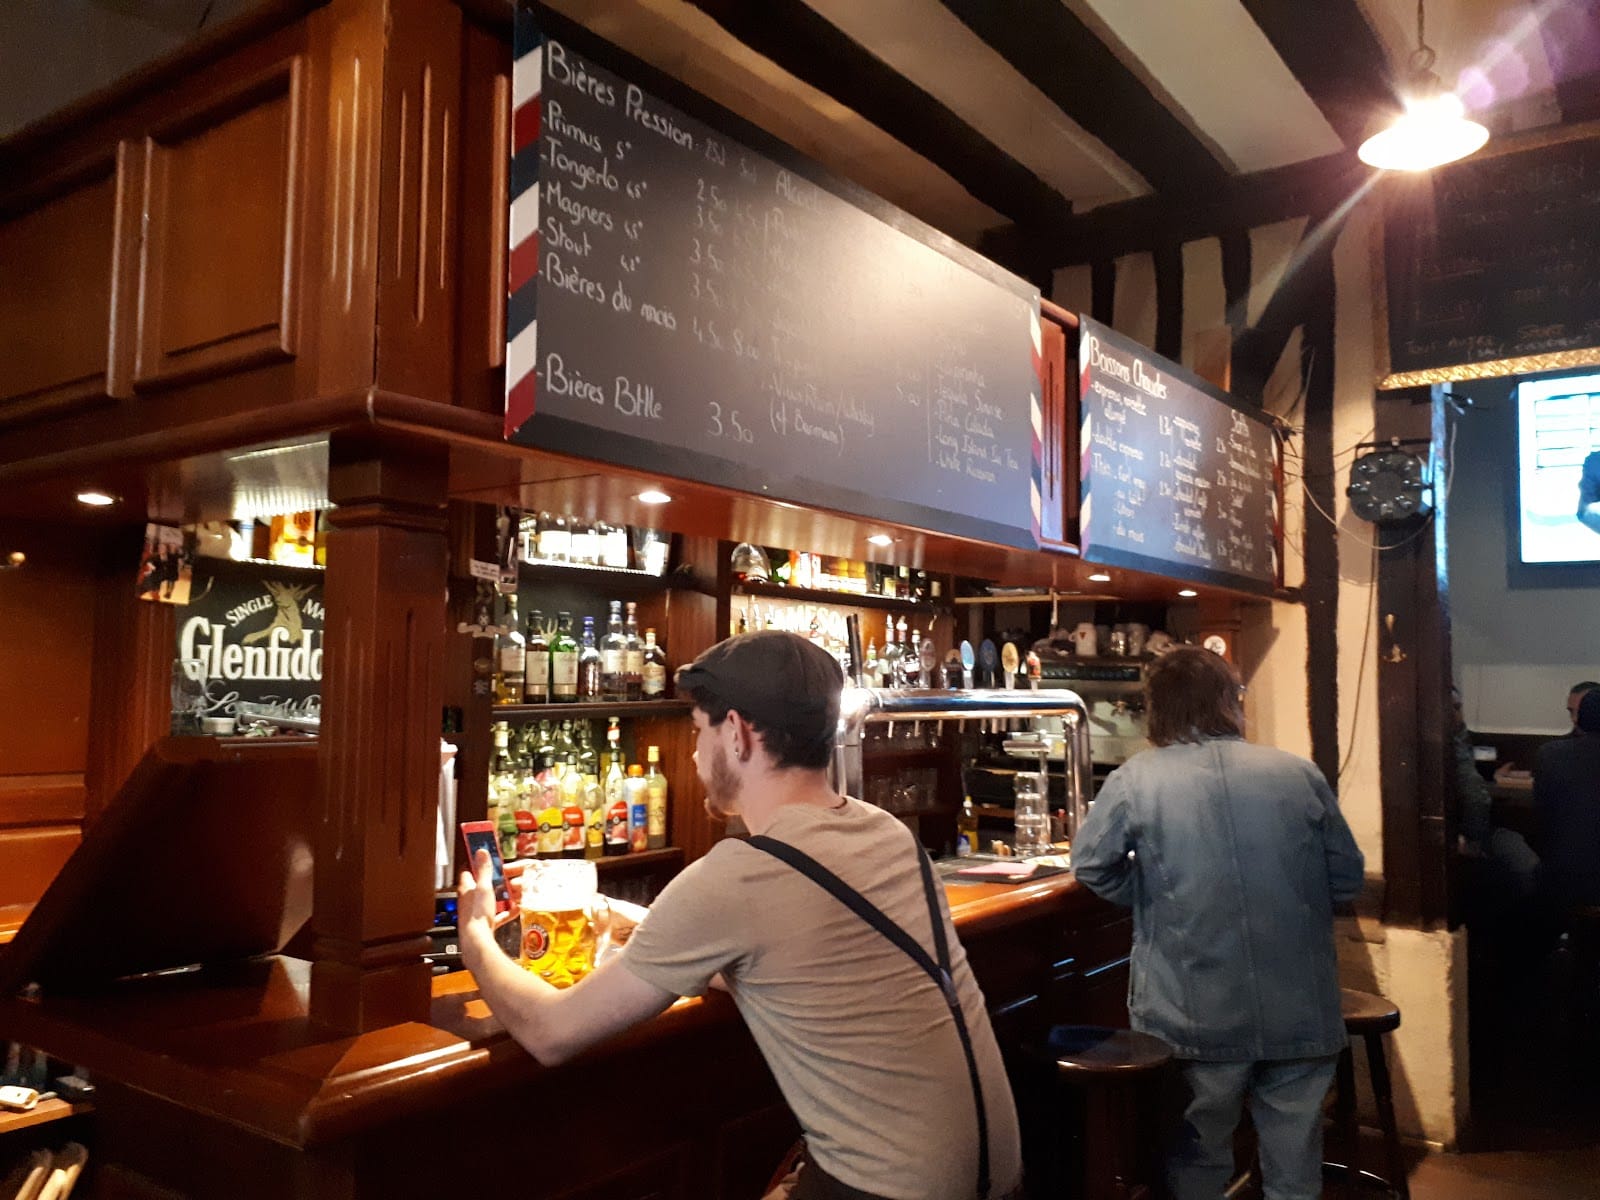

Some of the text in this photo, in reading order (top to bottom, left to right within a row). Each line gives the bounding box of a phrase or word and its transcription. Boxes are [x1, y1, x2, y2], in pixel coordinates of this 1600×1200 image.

[546, 40, 616, 107] Bières
[625, 84, 694, 150] Pression
[548, 99, 602, 153] Primus
[544, 135, 619, 191] Tongerlo
[546, 181, 613, 232] Magners
[546, 216, 592, 257] Stout
[546, 252, 605, 303] Bières
[611, 280, 632, 312] du
[640, 303, 676, 330] mois
[546, 352, 604, 405] Bières
[1090, 335, 1131, 383] Boissons
[225, 594, 274, 627] SINGLE
